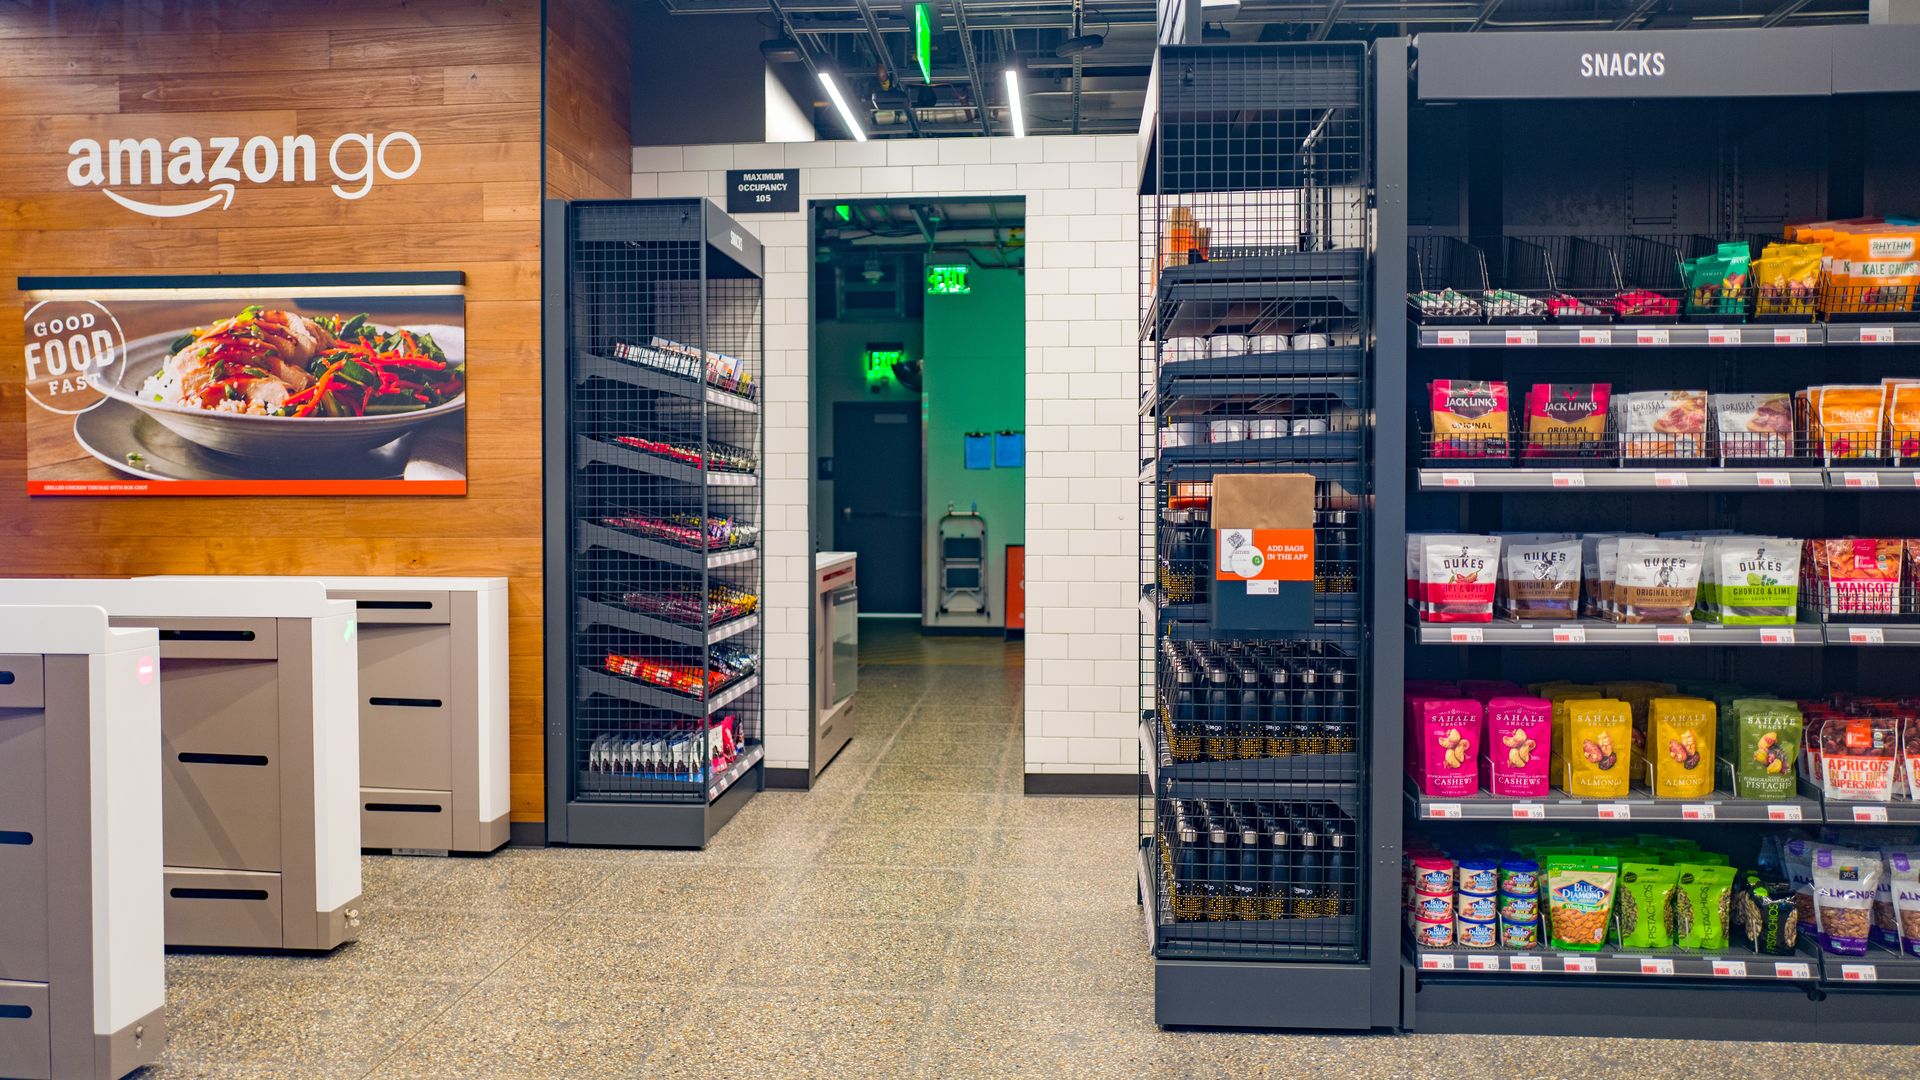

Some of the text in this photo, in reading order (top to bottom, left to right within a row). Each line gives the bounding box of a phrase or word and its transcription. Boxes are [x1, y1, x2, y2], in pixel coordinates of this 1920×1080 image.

[1581, 52, 1665, 77] SNACKS
[67, 132, 422, 200] amazon go
[743, 173, 784, 181] MAXIMUM
[738, 183, 788, 192] OCCUPANCY
[755, 194, 771, 202] 105
[1873, 241, 1912, 250] RHYTHM
[1862, 262, 1915, 275] KALE CHIPS
[933, 267, 966, 288] EXIT
[33, 313, 95, 337] GOOD
[24, 329, 115, 381] FOOD
[48, 372, 101, 396] FAST
[1444, 397, 1469, 408] JACK
[1542, 401, 1568, 412] JACK
[1636, 588, 1669, 598] ORIGINAL
[1733, 587, 1791, 596] CHORIZO & LIME
[1836, 582, 1893, 593] MANGOE
[1496, 713, 1545, 722] SAHALE
[1577, 714, 1625, 722] SAHALE
[1663, 713, 1707, 722] SAHALE
[1747, 716, 1796, 726] SAHALE
[1827, 759, 1890, 771] APRICOTS
[1434, 777, 1473, 786] CASHEWS
[1498, 777, 1541, 785] CASHEWS
[1573, 882, 1596, 892] BLUE
[1562, 888, 1606, 900] DIAMOND
[1820, 888, 1875, 899] ALMONDS
[1644, 884, 1657, 939] PISTACHIOS
[1701, 886, 1713, 941] PISTACHIOS
